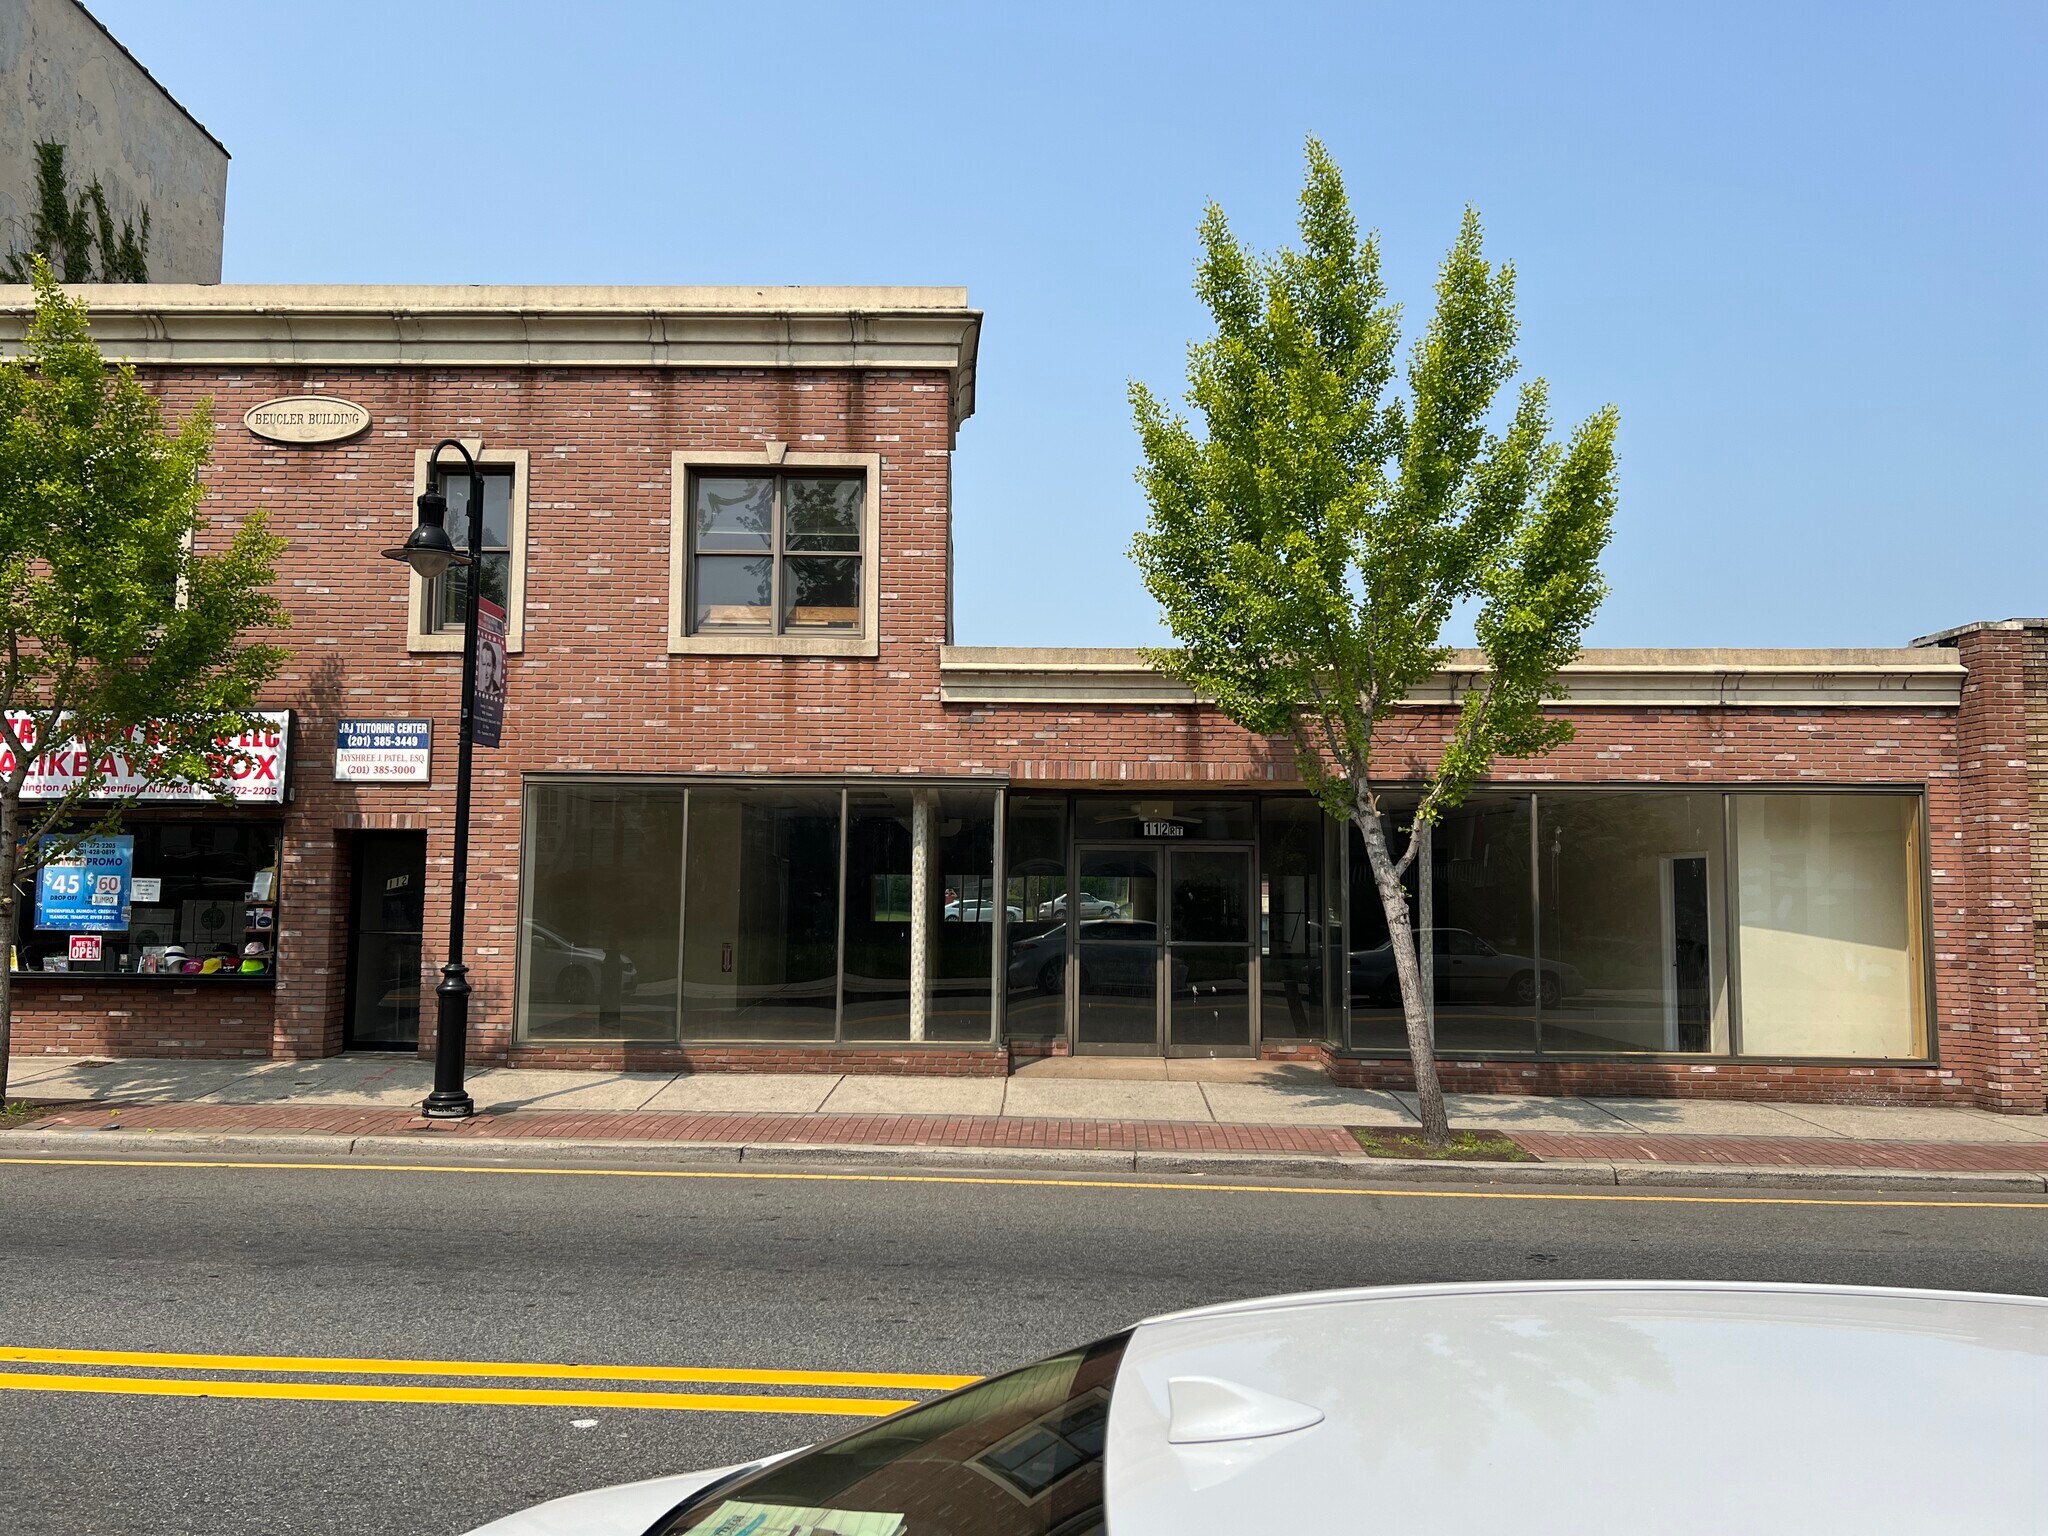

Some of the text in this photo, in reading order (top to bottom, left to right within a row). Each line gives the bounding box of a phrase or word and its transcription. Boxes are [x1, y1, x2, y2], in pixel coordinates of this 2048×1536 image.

[254, 413, 360, 425] BEUCLER BUILDING
[339, 723, 428, 734] J&J TUTORING CENTER
[347, 735, 418, 747] (201) 385-3449
[339, 753, 376, 763] JAYSHREE
[384, 753, 408, 764] PATEL,
[347, 765, 416, 775] (201) 385-3000
[148, 785, 161, 794] NJ
[86, 857, 123, 866] PROMO
[71, 946, 99, 959] OPEN
